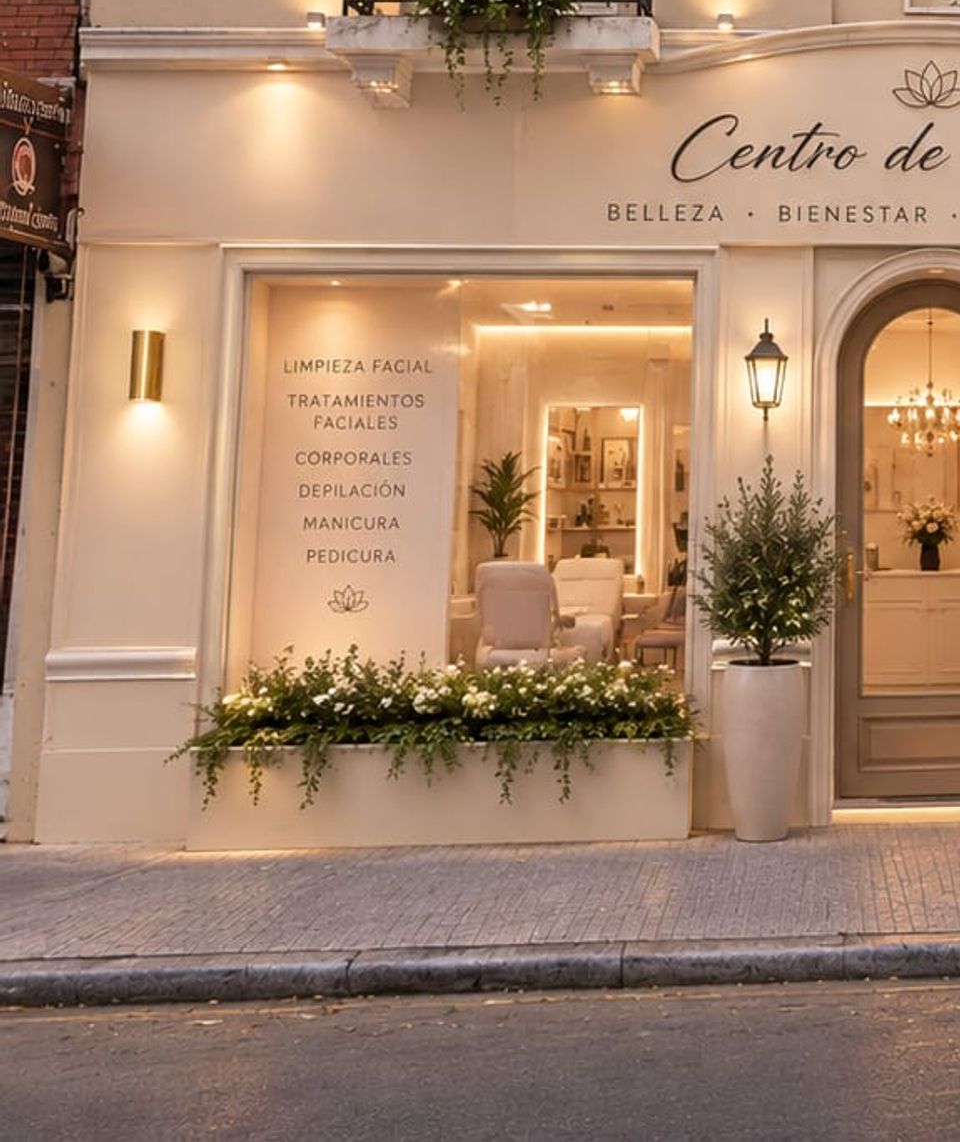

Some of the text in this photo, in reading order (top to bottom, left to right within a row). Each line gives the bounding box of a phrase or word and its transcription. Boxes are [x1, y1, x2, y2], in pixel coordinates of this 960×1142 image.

[670, 113, 867, 184] Centro
[884, 122, 951, 173] de
[607, 203, 724, 223] BELLEZA
[778, 204, 928, 224] BIENESTAR
[283, 358, 433, 375] LIMPIEZA FACIAL
[287, 393, 425, 409] TRATAMIENTOS
[313, 415, 398, 431] FACIALES
[295, 450, 412, 466] CORPORALES
[298, 479, 406, 499] DEPILACIÓN
[303, 515, 401, 531] MANICURA
[306, 548, 396, 564] PEDICURA
